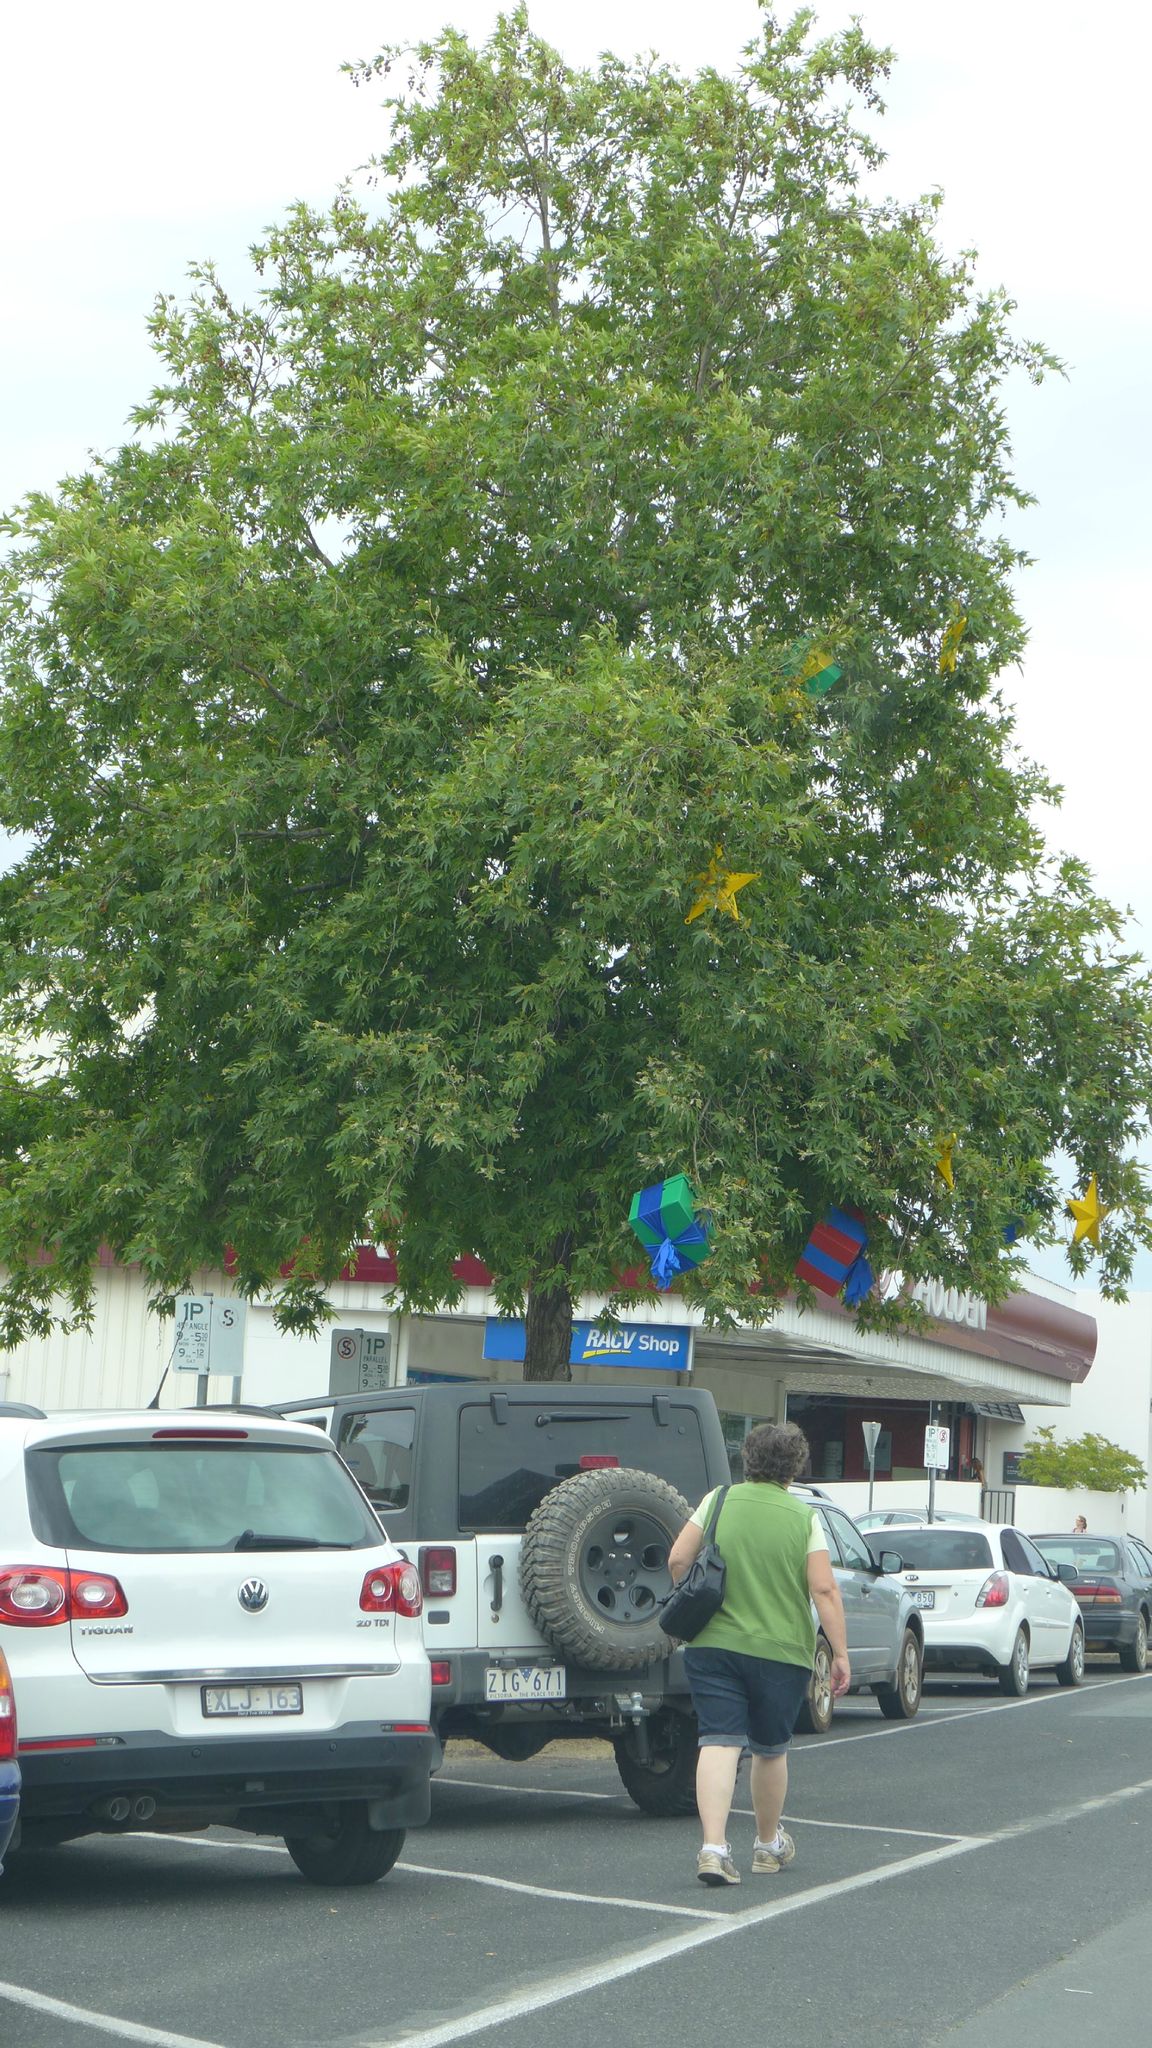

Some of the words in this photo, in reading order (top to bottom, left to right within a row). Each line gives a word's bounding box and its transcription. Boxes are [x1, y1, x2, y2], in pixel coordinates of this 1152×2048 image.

[183, 1302, 204, 1320] 1P
[222, 1309, 234, 1326] S
[189, 1323, 208, 1331] ANGLE
[341, 1340, 352, 1356] S
[366, 1338, 386, 1355] 1P
[585, 1328, 637, 1350] RACV
[638, 1334, 680, 1356] Shop
[80, 1625, 134, 1636] TIGUAN
[373, 1619, 389, 1627] TDI
[488, 1672, 520, 1693] ZIG
[533, 1670, 561, 1691] 671
